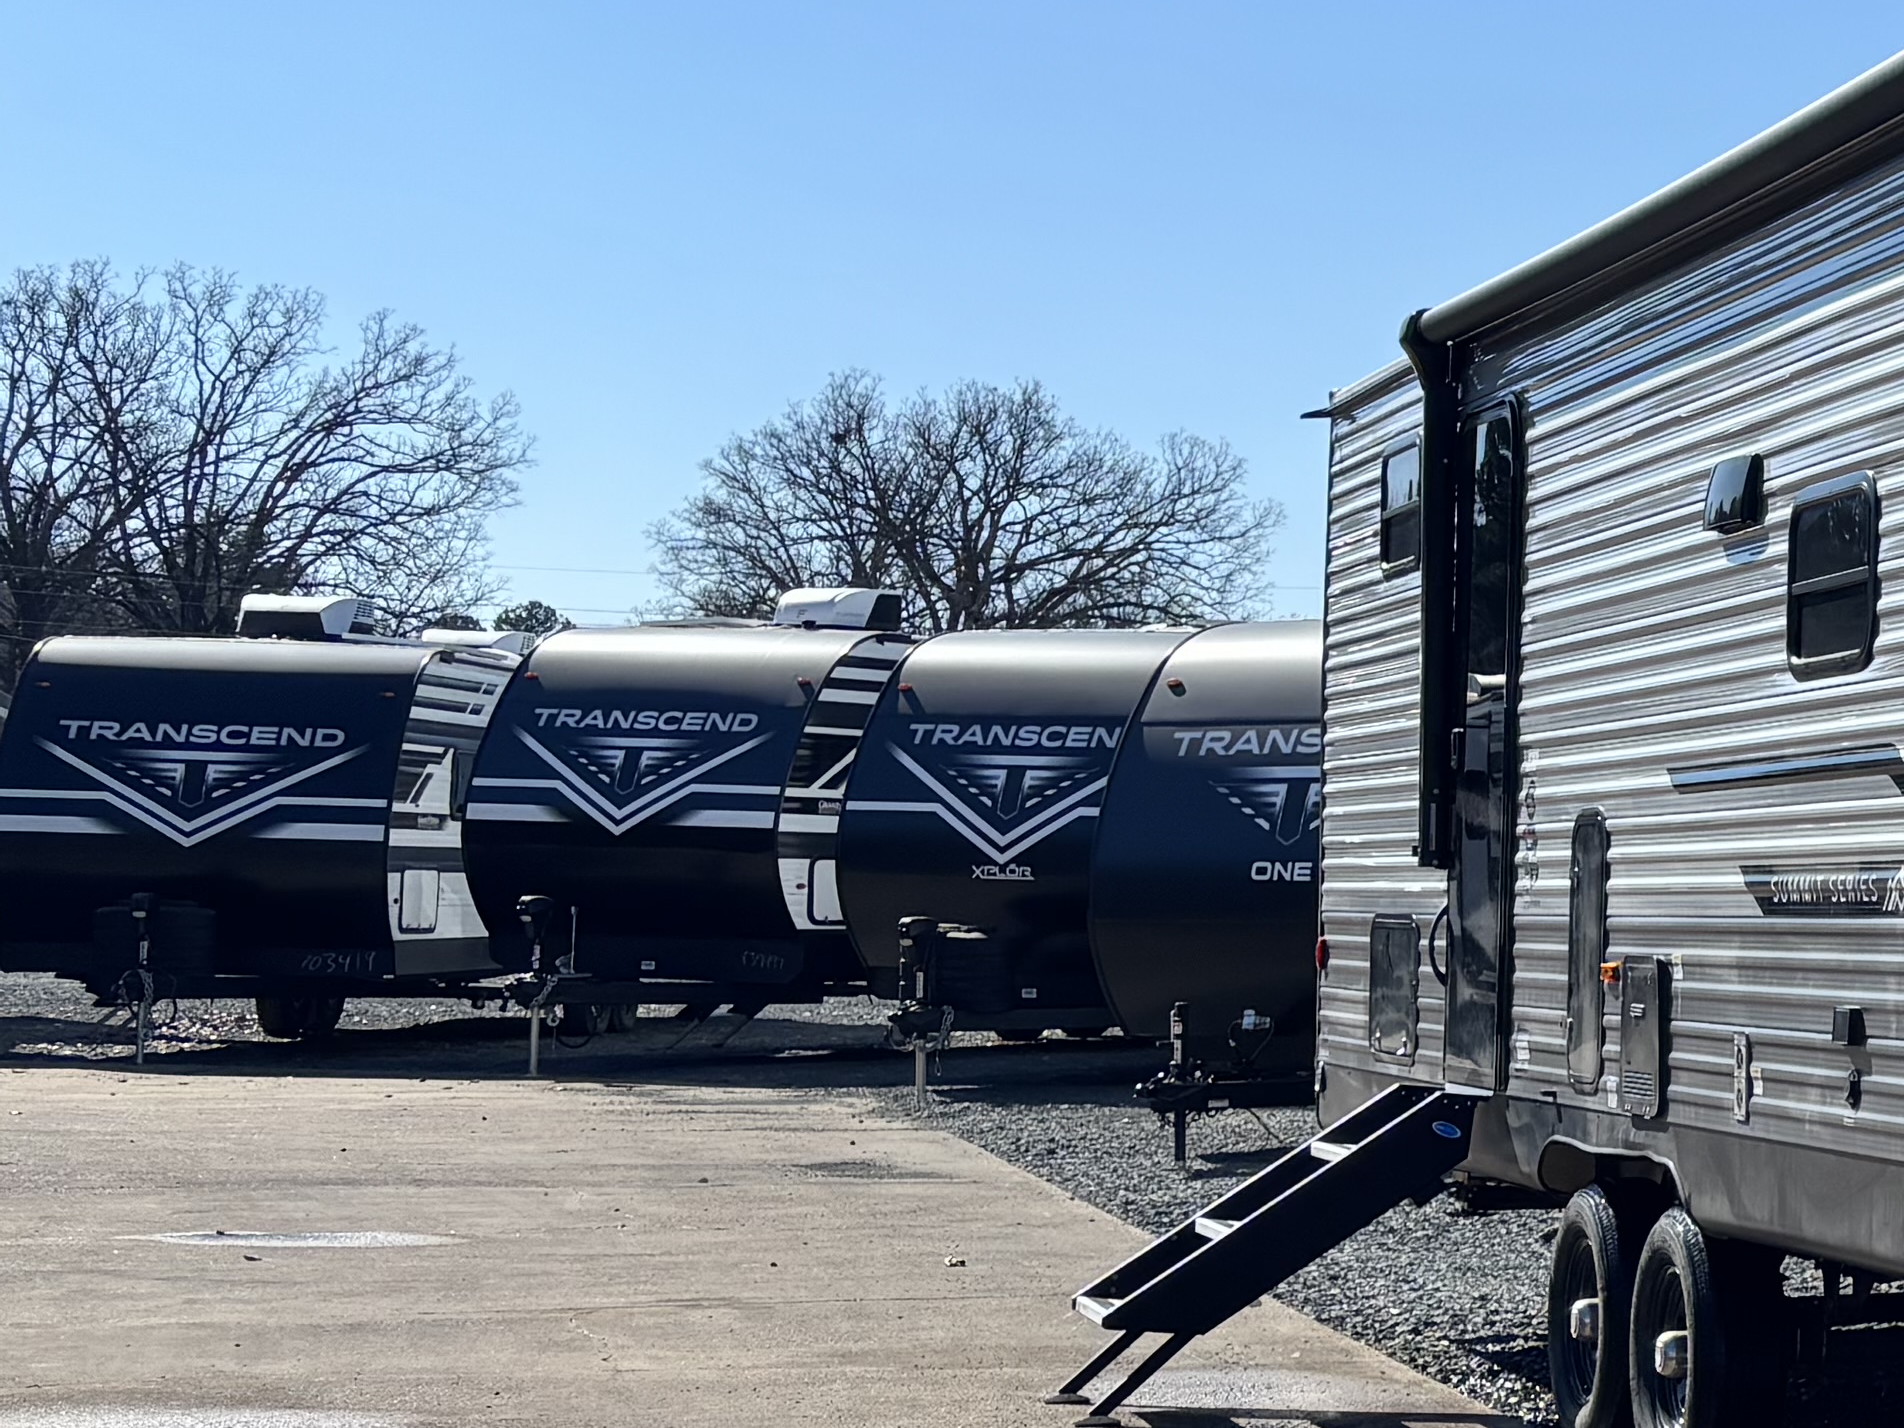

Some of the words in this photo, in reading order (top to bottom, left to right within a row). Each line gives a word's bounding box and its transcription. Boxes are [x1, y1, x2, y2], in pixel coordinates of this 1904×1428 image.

[533, 708, 759, 732] TRANSCEND
[59, 719, 346, 748] TRANSCEND
[1250, 861, 1313, 882] ONE
[1771, 874, 1825, 903] SUMMIT
[1829, 873, 1878, 902] SERIES
